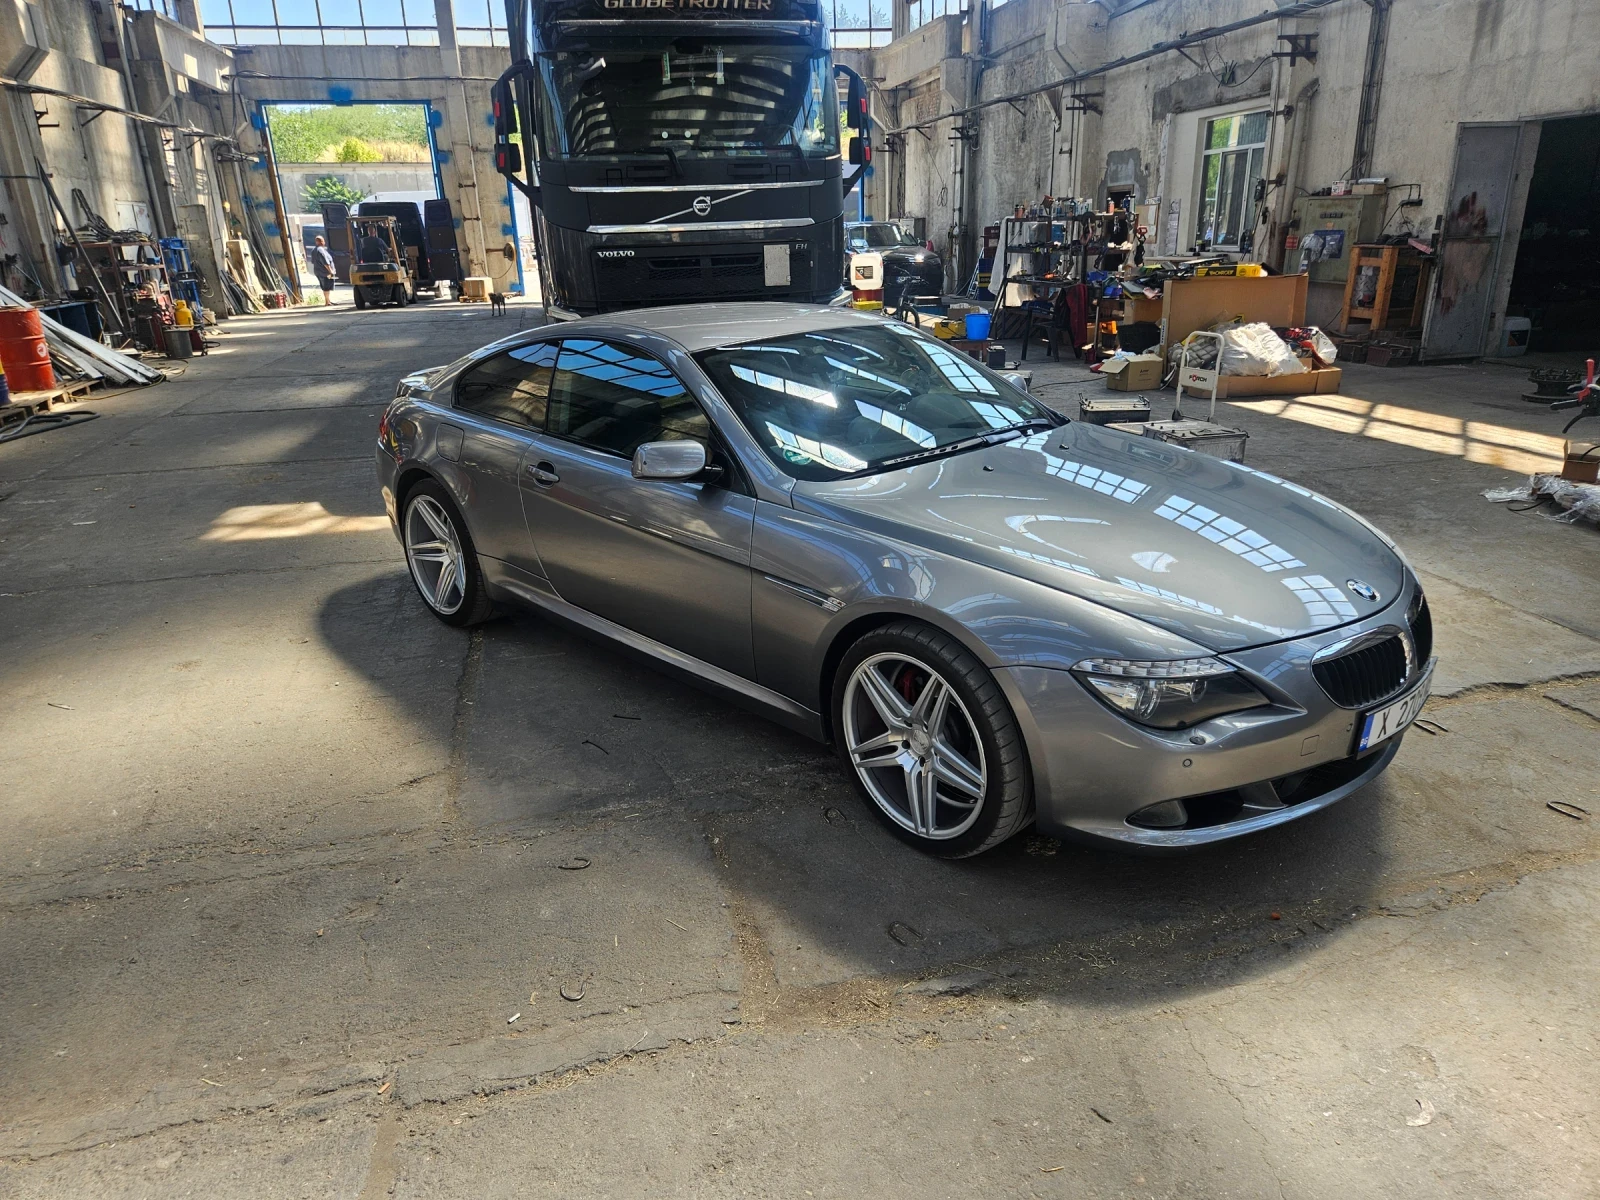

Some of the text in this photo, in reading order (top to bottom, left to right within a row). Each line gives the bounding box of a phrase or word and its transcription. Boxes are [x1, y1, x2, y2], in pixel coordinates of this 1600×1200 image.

[604, 0, 772, 10] GLOBETROTTER
[596, 250, 635, 258] VOLVO
[1377, 708, 1391, 739] X
